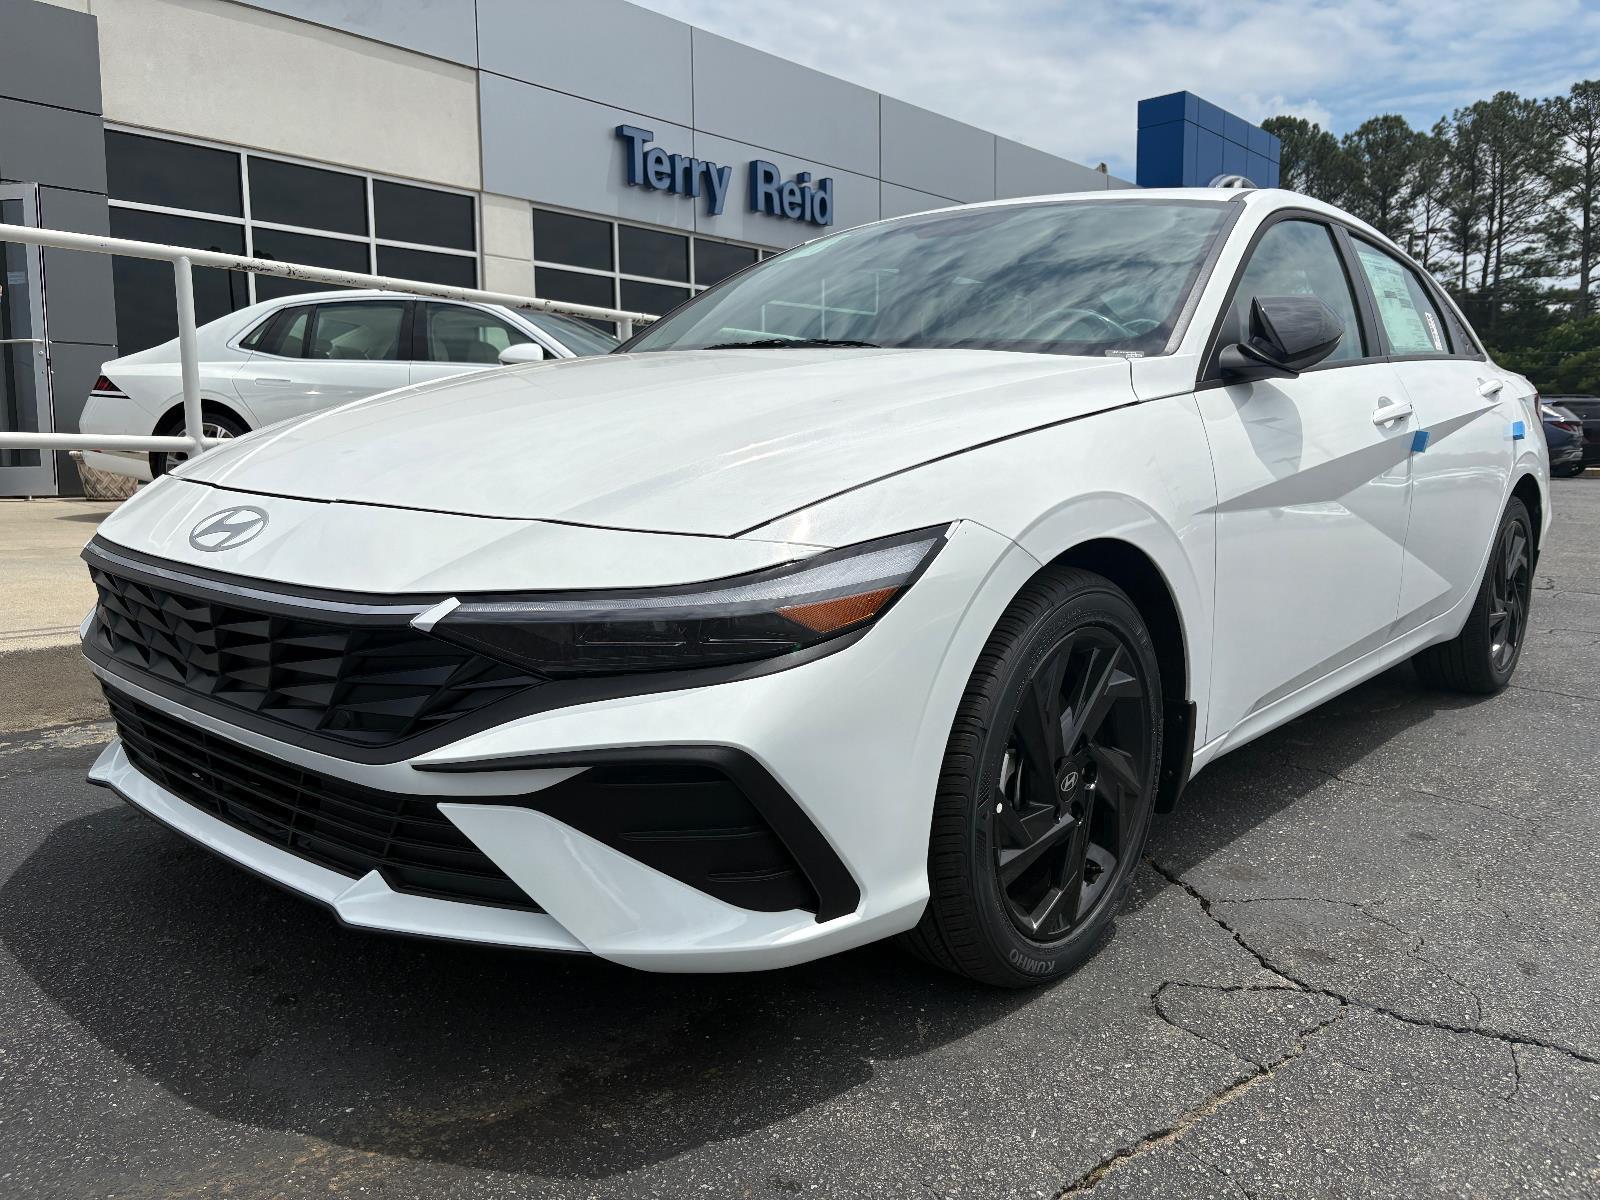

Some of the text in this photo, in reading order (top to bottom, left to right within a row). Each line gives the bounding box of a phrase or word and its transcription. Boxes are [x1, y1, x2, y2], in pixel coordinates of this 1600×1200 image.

[615, 124, 834, 226] Terry Reid
[1009, 948, 1056, 974] KUMHO
